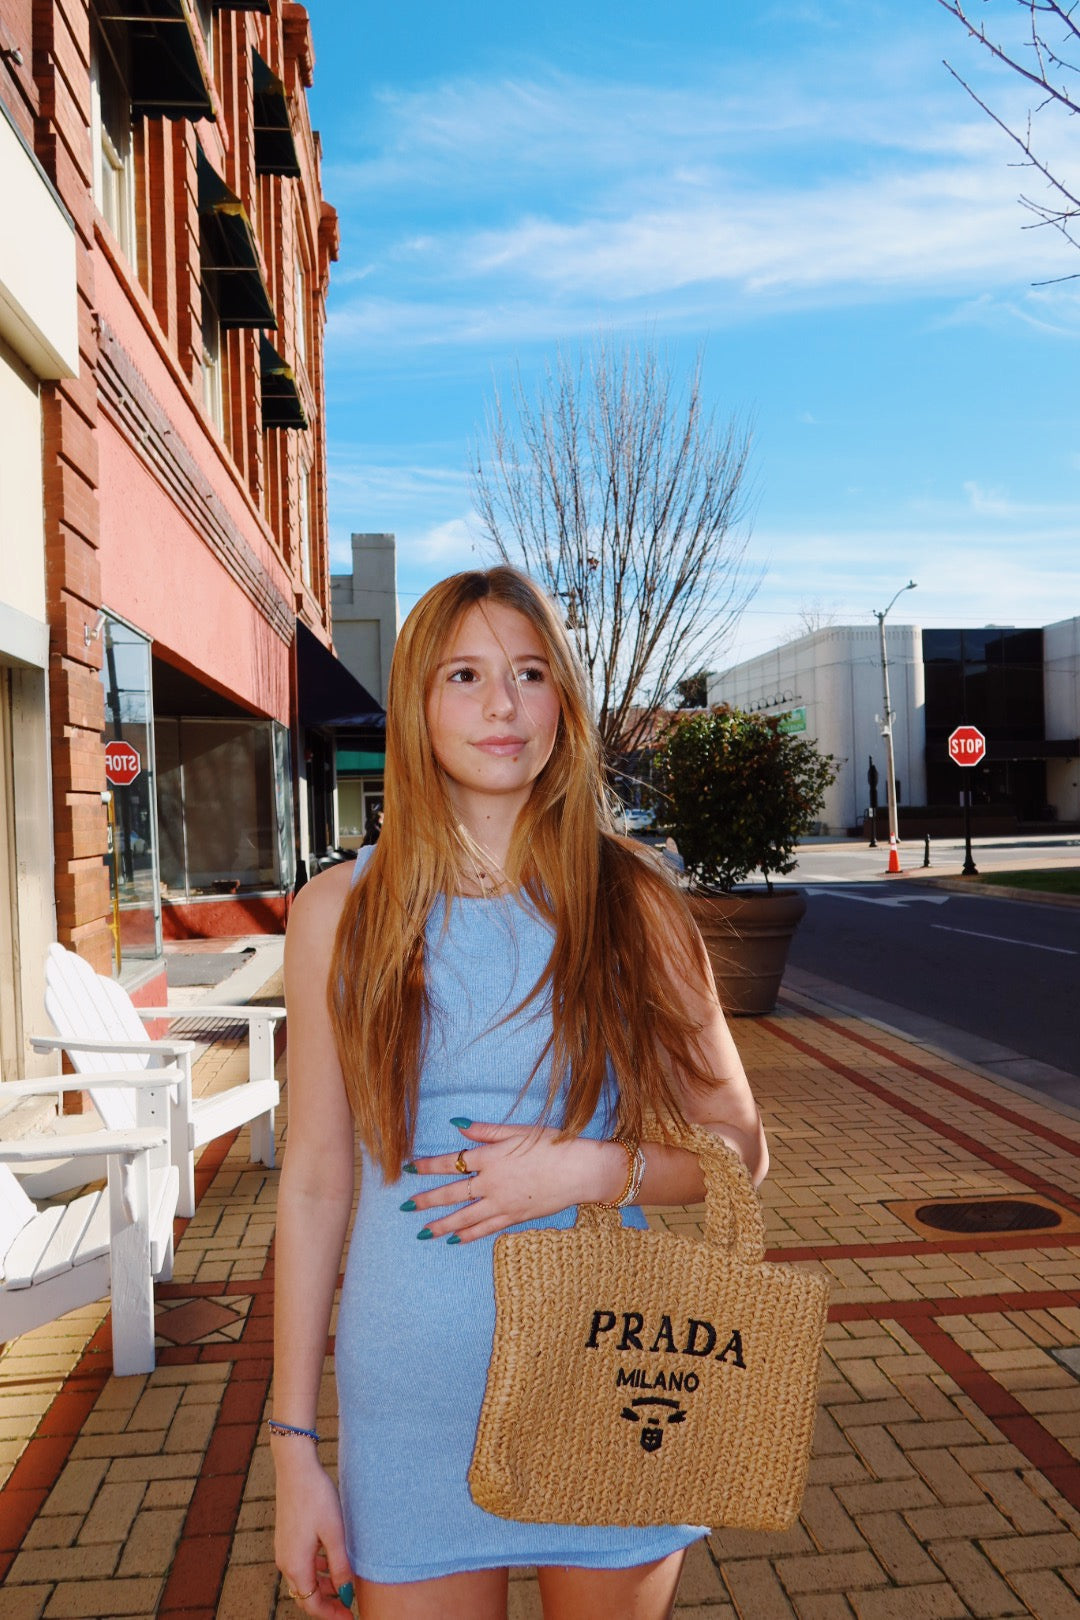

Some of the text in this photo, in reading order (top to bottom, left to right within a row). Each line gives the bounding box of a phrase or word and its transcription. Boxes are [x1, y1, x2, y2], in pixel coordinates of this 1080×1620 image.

[951, 738, 983, 754] STOP
[584, 1310, 747, 1370] PRADA
[616, 1367, 700, 1393] MILANO
